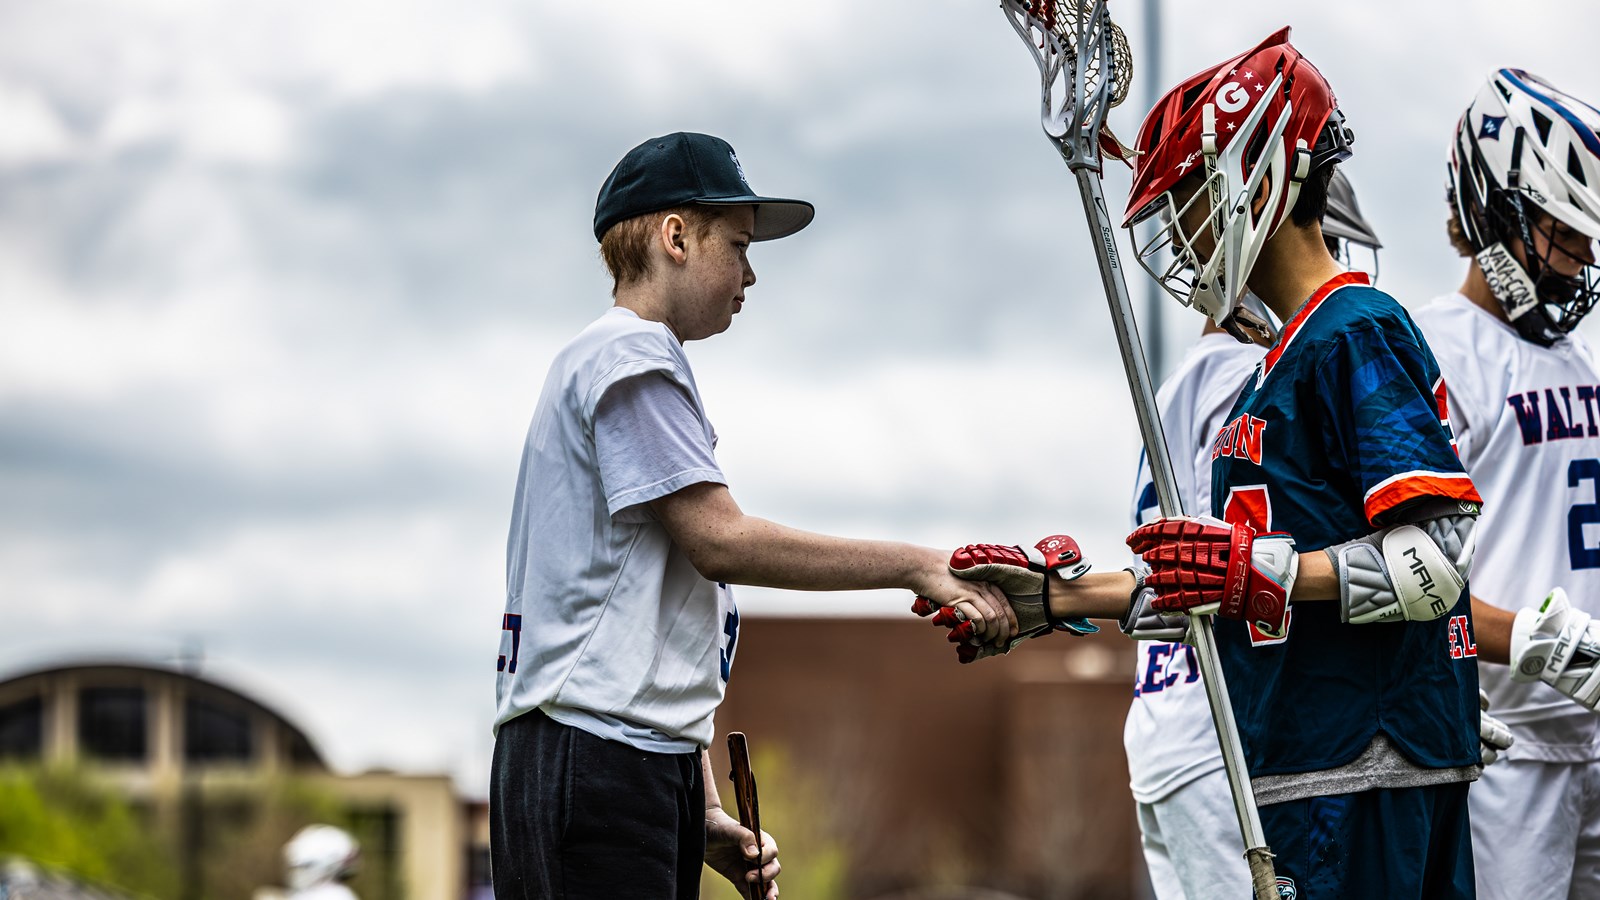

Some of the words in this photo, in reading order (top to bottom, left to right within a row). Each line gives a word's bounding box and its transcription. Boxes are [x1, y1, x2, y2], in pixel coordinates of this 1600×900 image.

[1215, 81, 1251, 114] G
[1102, 226, 1118, 269] Scandium
[1477, 254, 1505, 296] DIOS
[1402, 546, 1448, 618] MAVE
[1133, 641, 1201, 698] ECT
